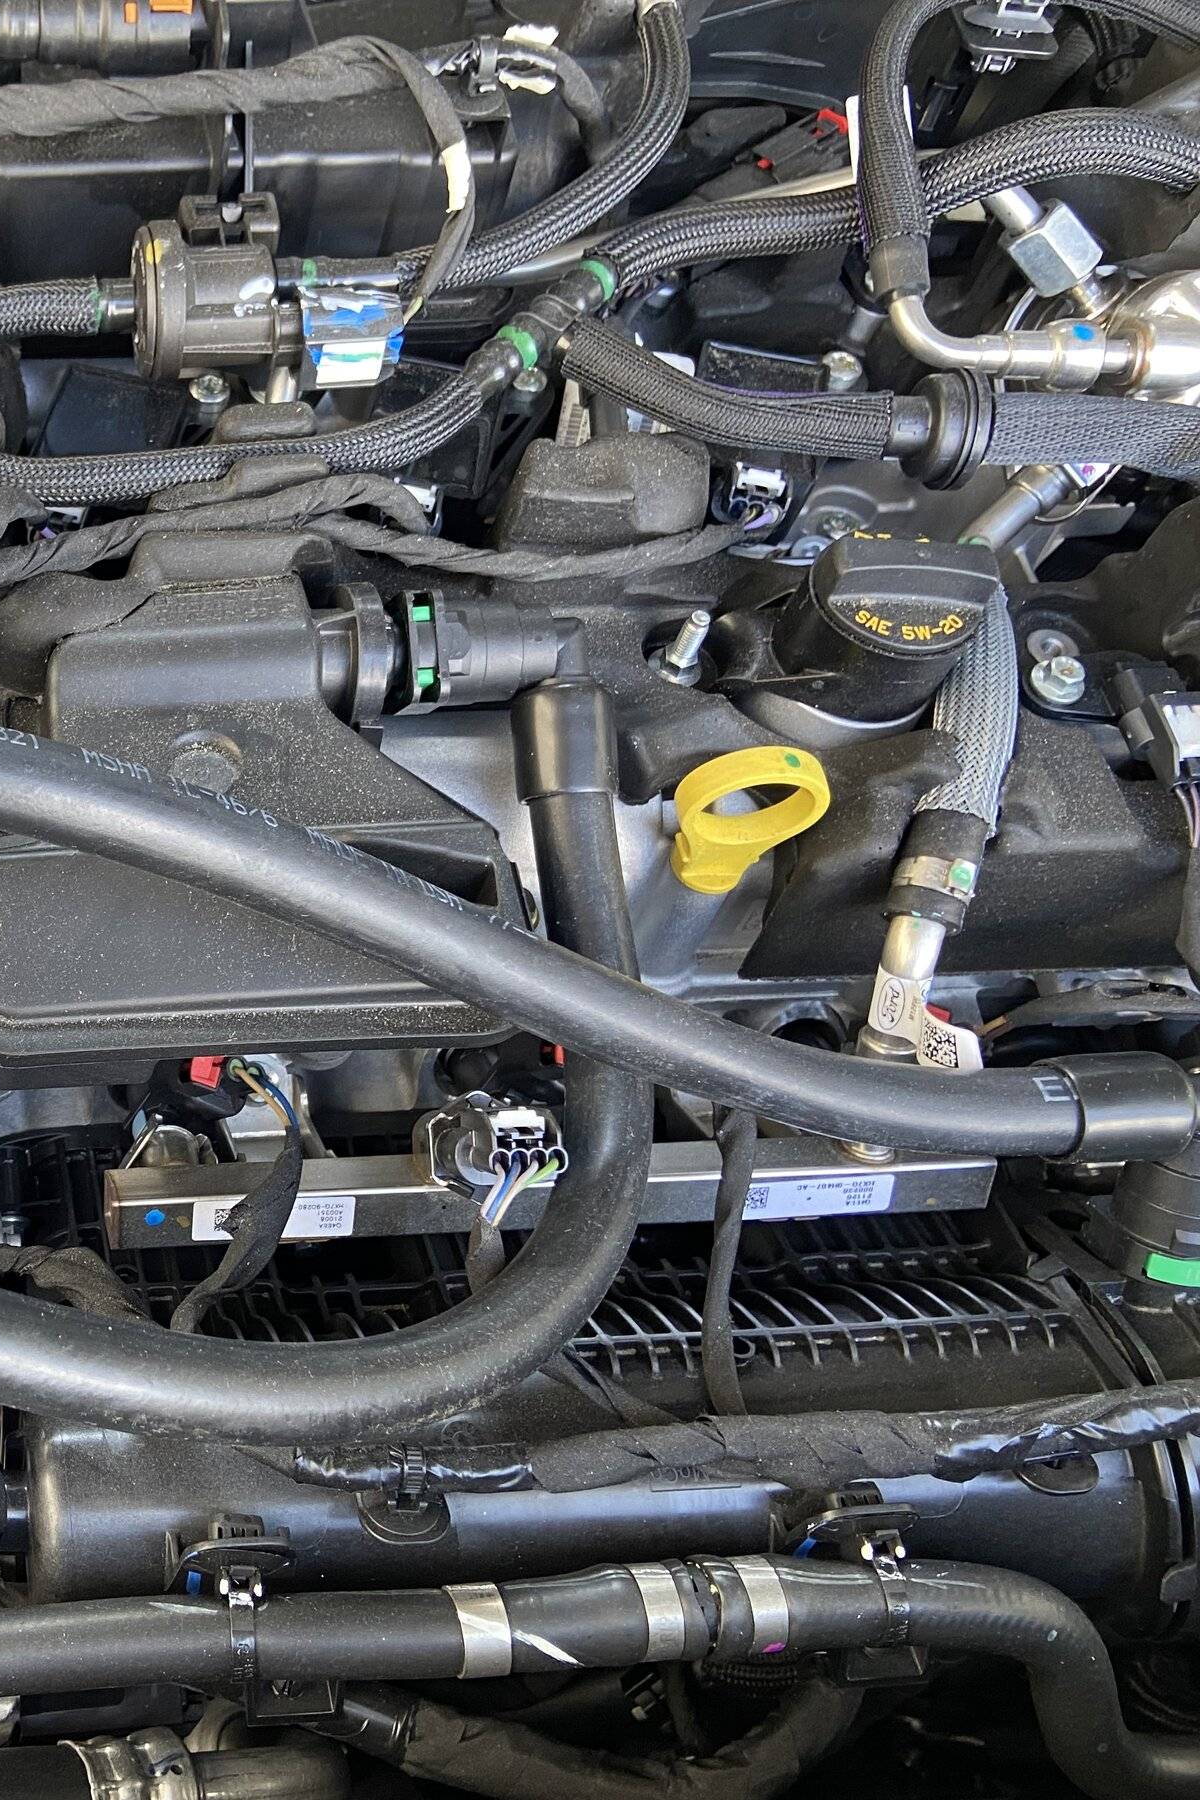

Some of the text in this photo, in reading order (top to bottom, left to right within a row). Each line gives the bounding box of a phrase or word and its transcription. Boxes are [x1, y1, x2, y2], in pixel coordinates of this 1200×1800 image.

[855, 610, 964, 641] SAE 5W-20
[80, 747, 153, 783] MSHA
